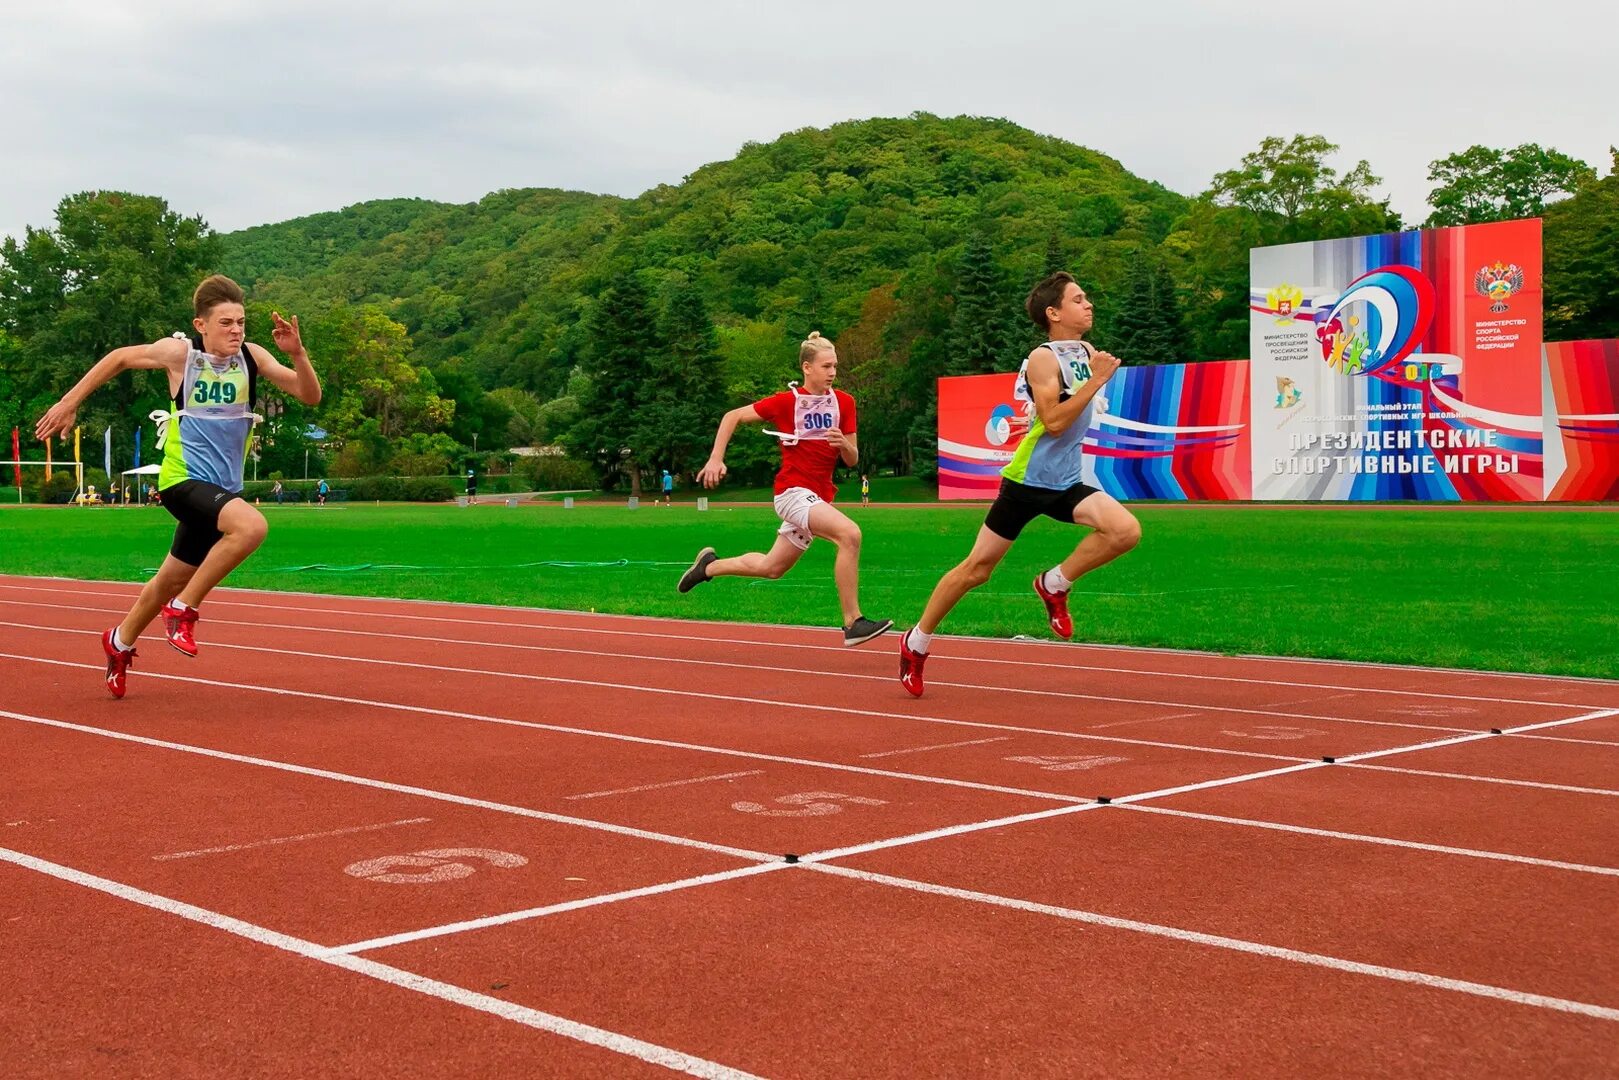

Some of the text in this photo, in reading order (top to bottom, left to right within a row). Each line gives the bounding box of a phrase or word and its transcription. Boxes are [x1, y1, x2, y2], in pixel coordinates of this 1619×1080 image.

[1070, 361, 1091, 381] 34
[1391, 363, 1442, 381] 2018
[194, 380, 236, 404] 349
[804, 412, 832, 429] 306
[1359, 412, 1408, 421] СПОРТИВНЫХ
[1411, 412, 1426, 420] ИГР
[1290, 429, 1497, 451] ПРЕЗИДЕНТСКИЕ
[1272, 454, 1519, 475] СПОРТИВНЫЕ ИГРЫ
[1000, 754, 1132, 771] 4
[731, 791, 890, 818] 5
